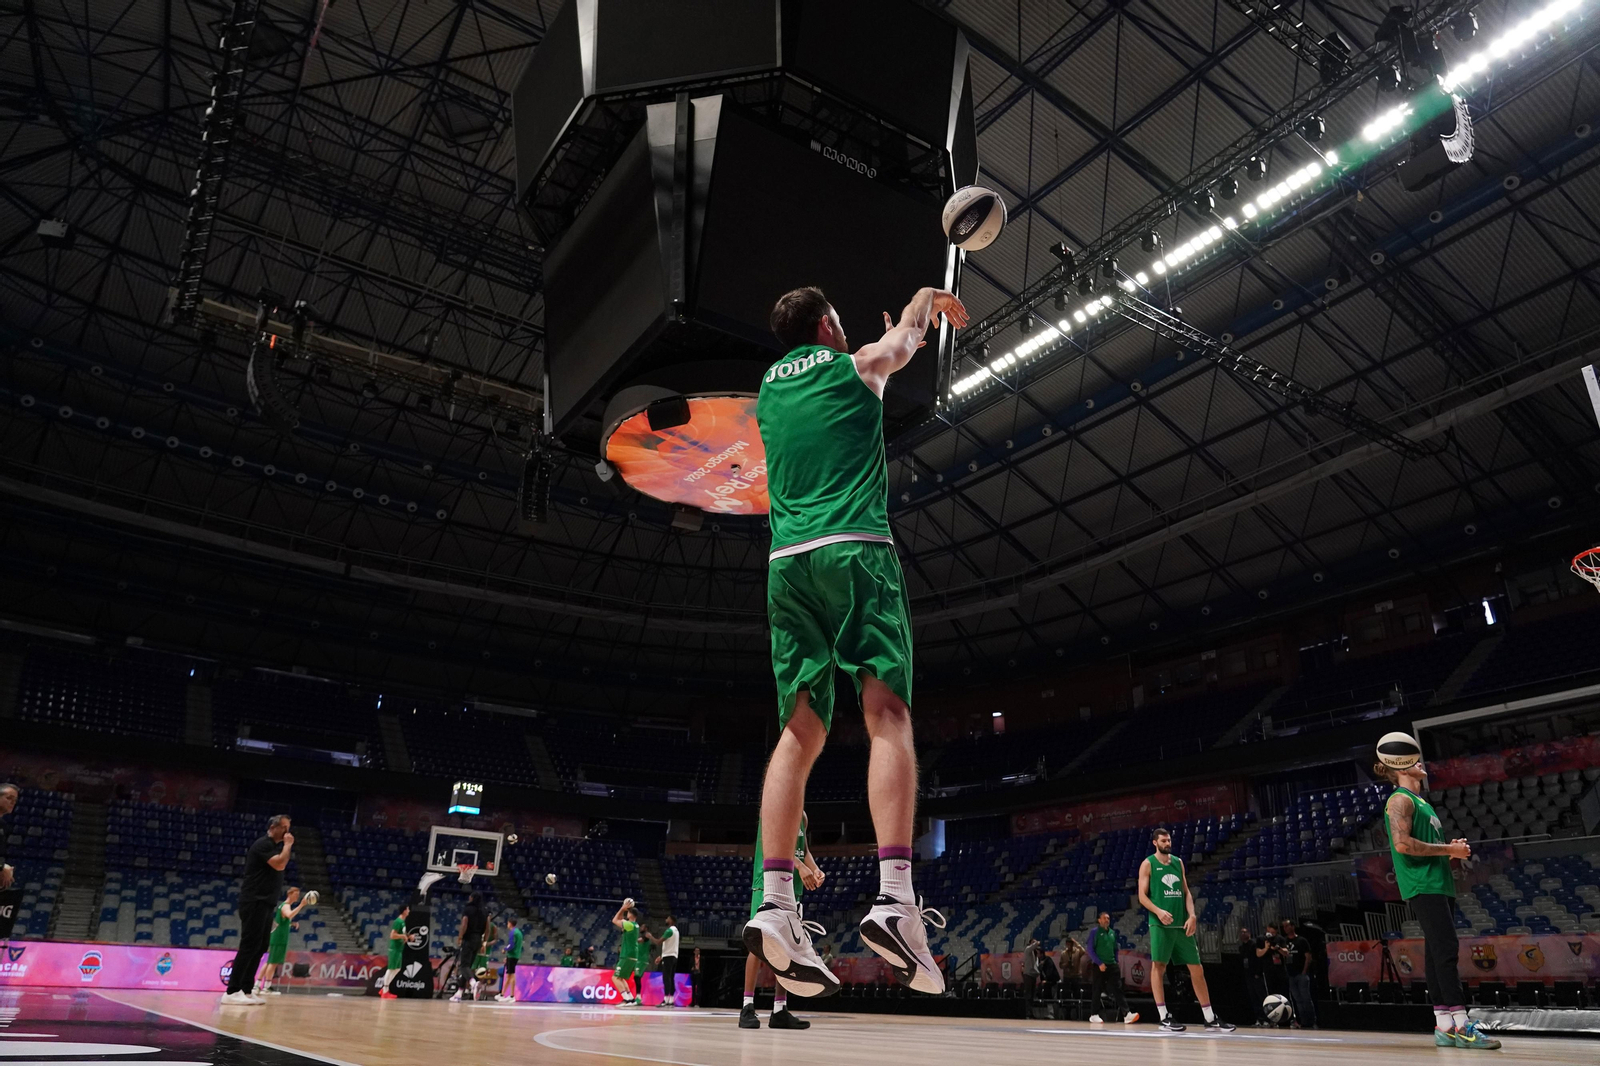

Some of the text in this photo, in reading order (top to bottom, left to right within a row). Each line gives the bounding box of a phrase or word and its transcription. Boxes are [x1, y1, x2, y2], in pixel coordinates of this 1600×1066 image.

[823, 146, 877, 178] MONDO
[683, 467, 711, 483] 2024
[704, 478, 751, 500] Rey
[1384, 757, 1414, 766] SPALDING
[461, 782, 483, 793] 11:14
[1338, 951, 1365, 962] acb
[396, 979, 426, 991] Unicaja
[582, 983, 617, 1000] acb
